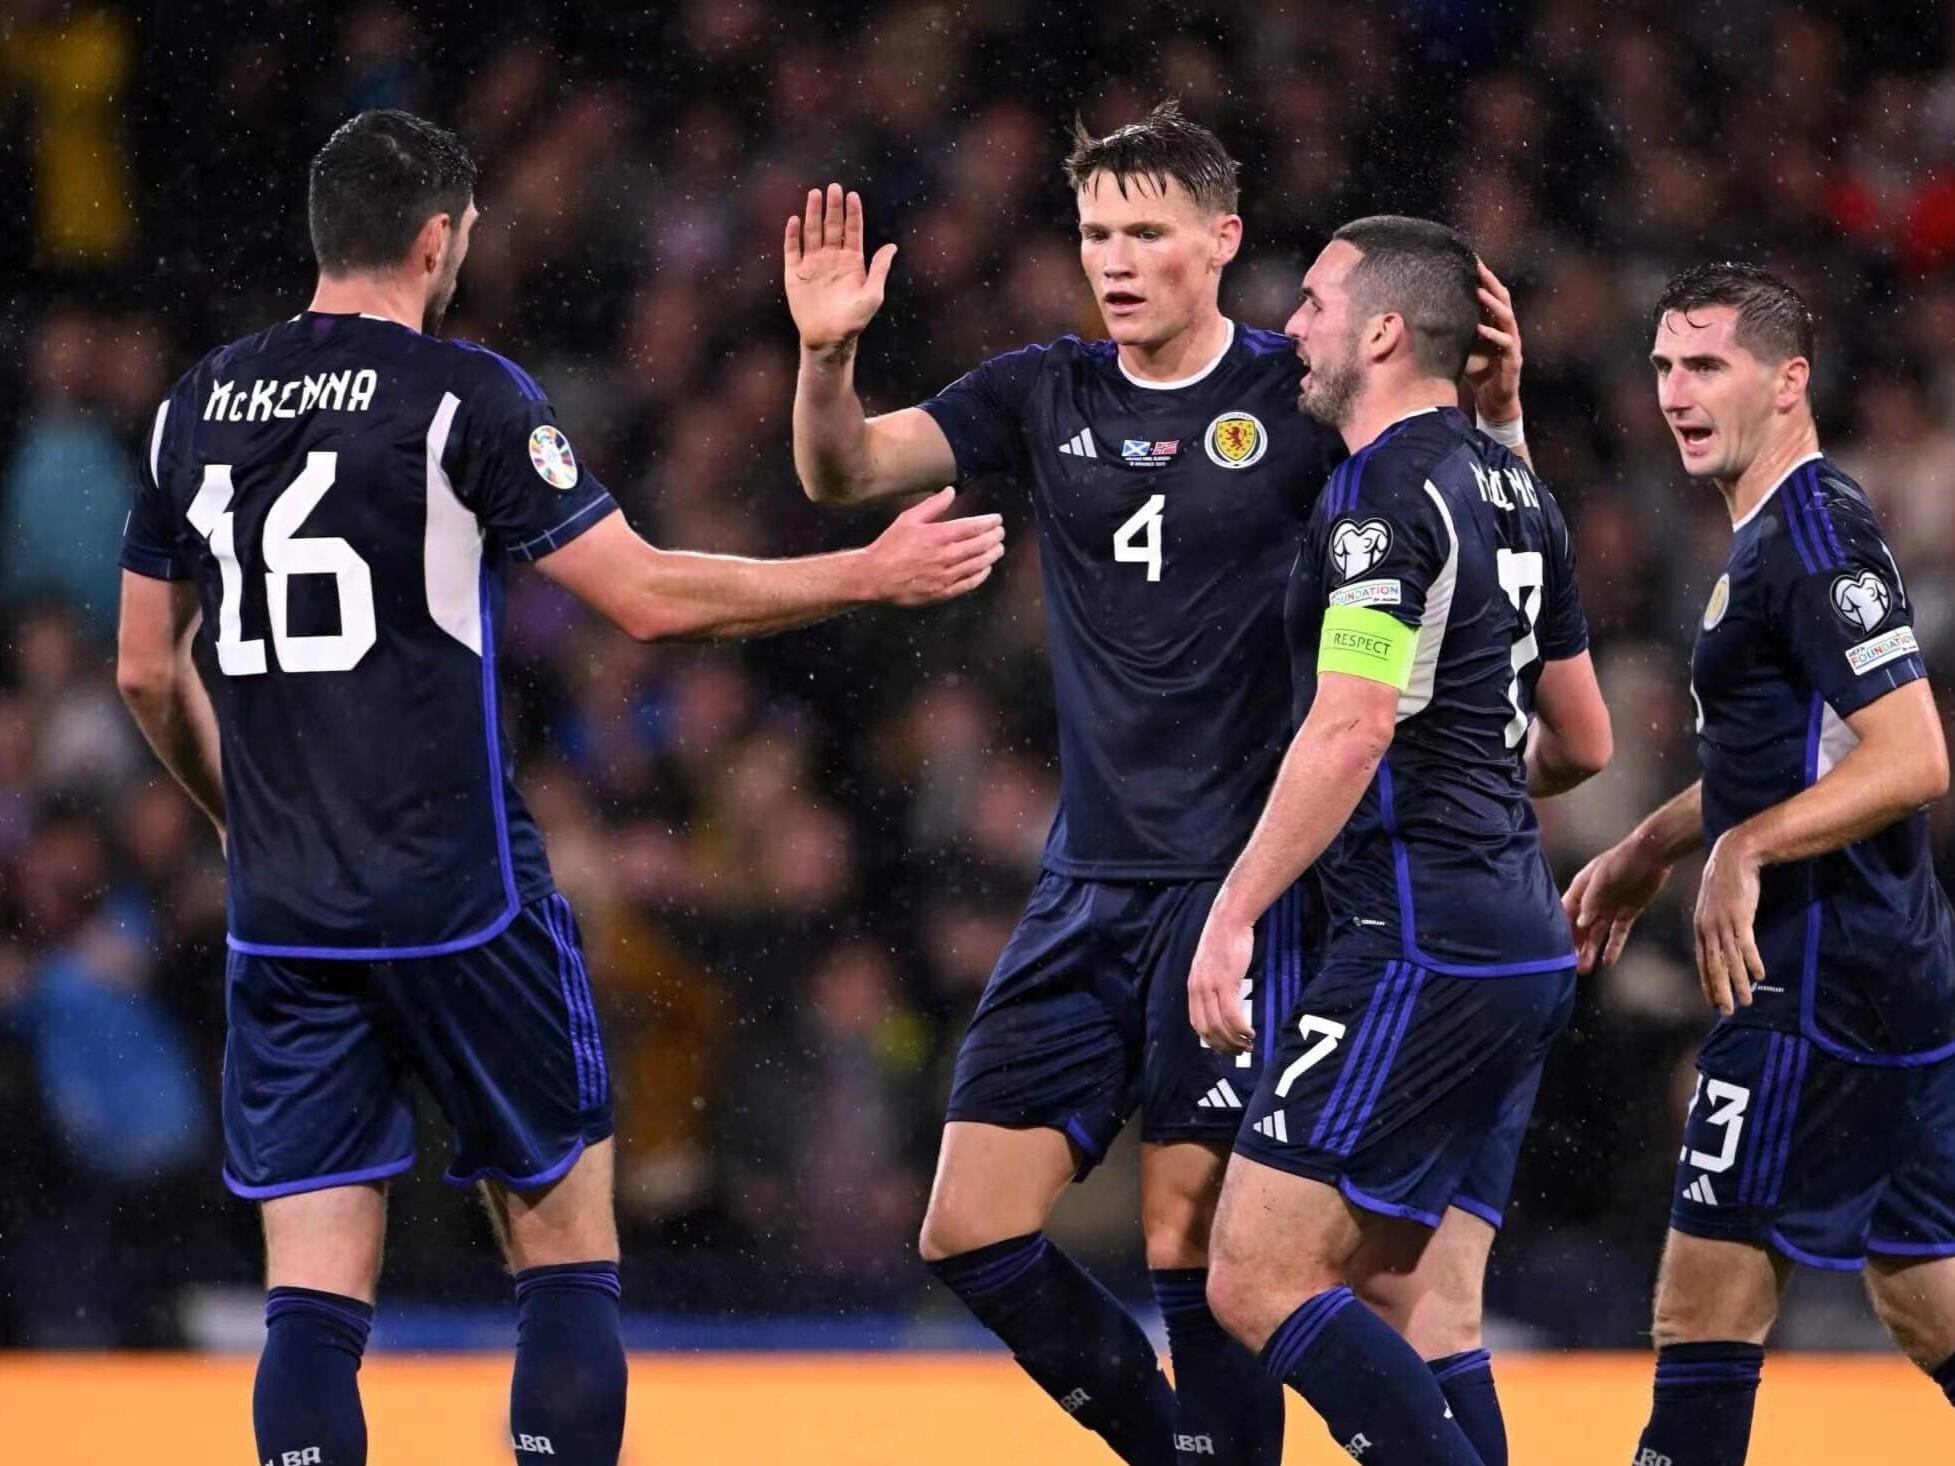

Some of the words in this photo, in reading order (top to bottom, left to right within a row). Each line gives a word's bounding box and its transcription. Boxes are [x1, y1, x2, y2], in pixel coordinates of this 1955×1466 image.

[204, 369, 377, 422] McKENNA
[186, 451, 377, 676] 16
[1113, 494, 1165, 582] 4
[1334, 632, 1391, 656] RESPECT
[1275, 1014, 1346, 1097] 7
[1680, 1072, 1750, 1173] 3
